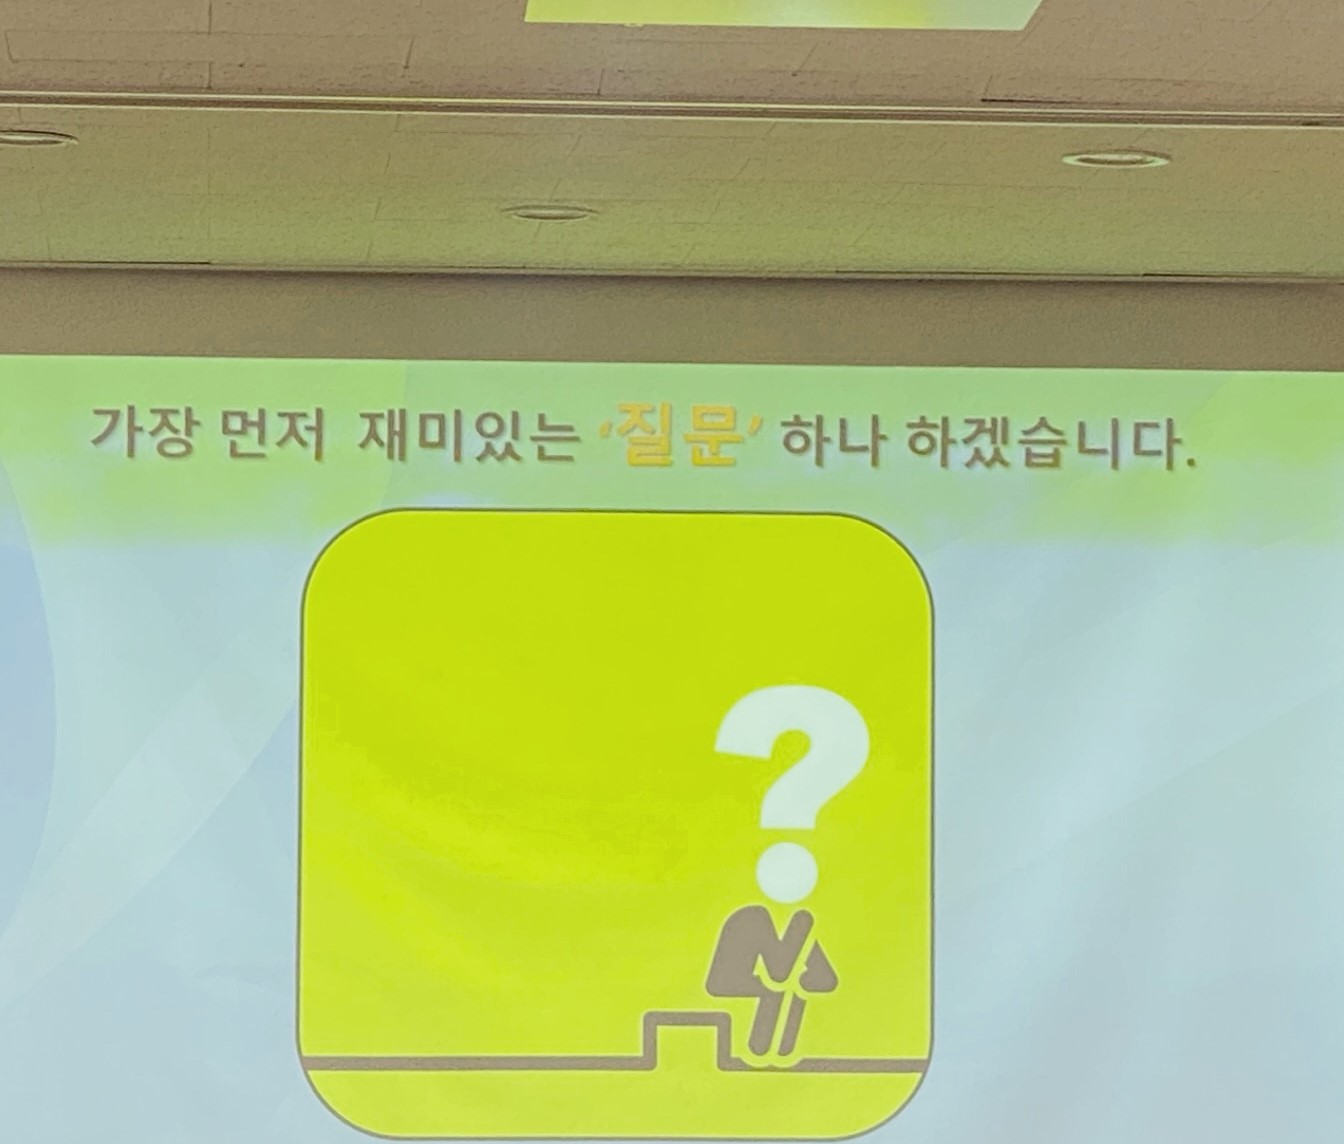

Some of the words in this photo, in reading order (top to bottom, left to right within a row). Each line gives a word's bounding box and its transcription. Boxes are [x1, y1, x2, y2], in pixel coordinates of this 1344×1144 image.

[92, 404, 202, 460] 가장
[221, 406, 326, 462] 먼저
[358, 407, 583, 464] 재미있는
[780, 414, 889, 469] 하나
[906, 415, 1198, 471] 하겠습니다.
